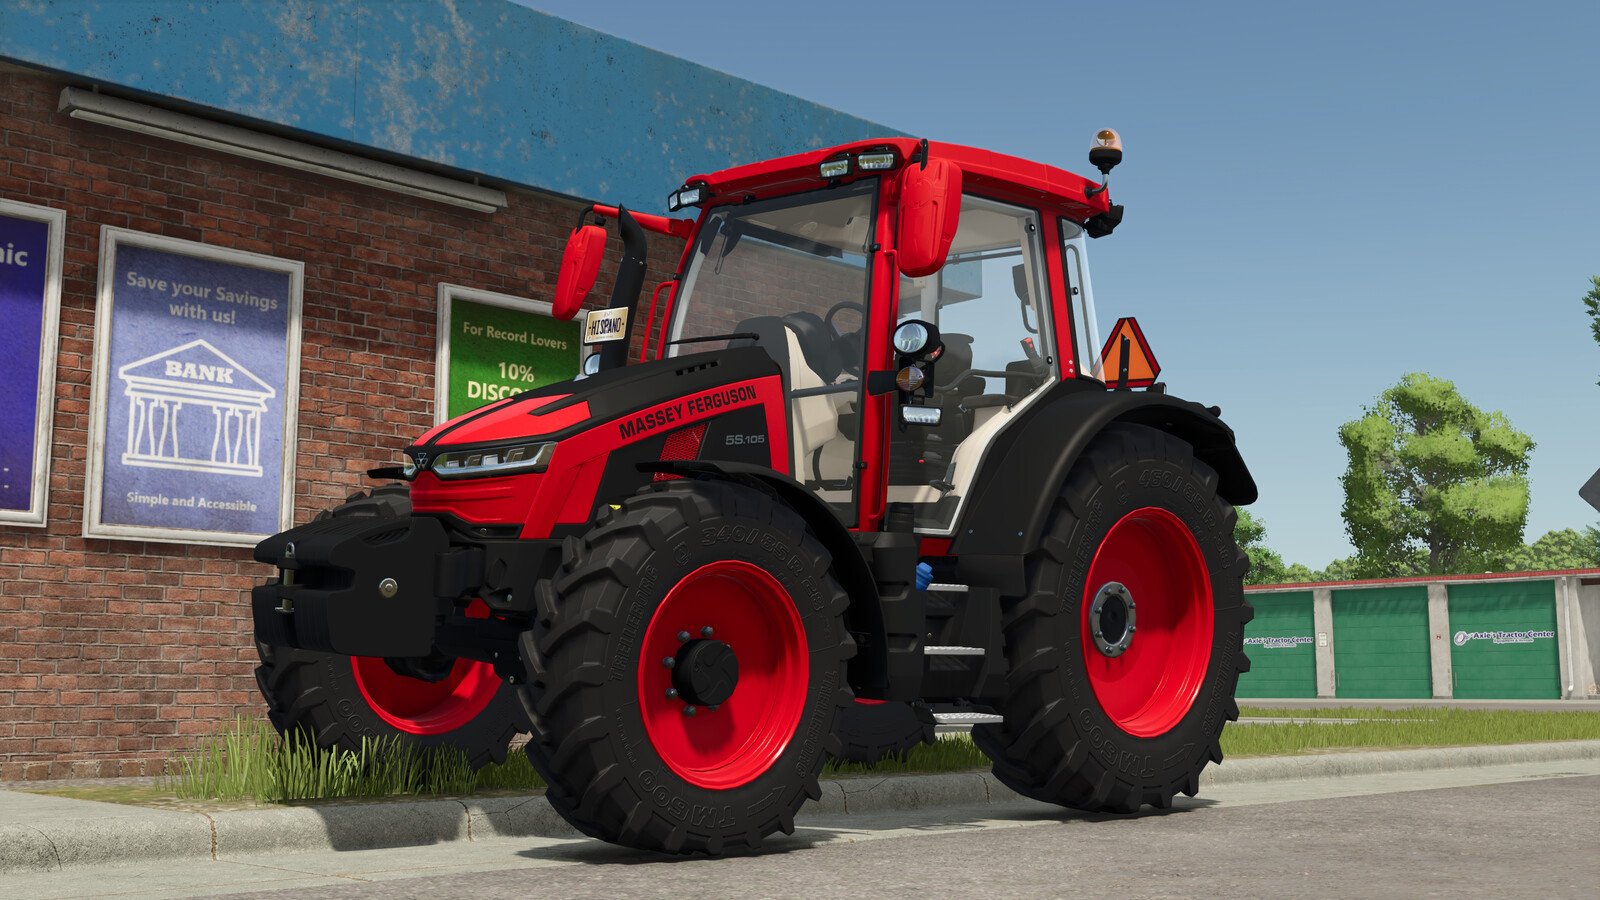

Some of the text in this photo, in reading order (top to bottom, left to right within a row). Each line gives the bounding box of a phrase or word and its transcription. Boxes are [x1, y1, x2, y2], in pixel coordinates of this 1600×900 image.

[126, 271, 278, 312] Save your Savings
[169, 301, 236, 325] with us!
[463, 321, 567, 351] For Record Lovers
[165, 360, 235, 385] BANK
[498, 361, 535, 383] 10%
[618, 384, 757, 440] MASSEY FERGUSON
[725, 434, 765, 446] 5S.105
[127, 491, 257, 513] Simple and Accessible
[1473, 631, 1496, 639] Axle's
[1527, 630, 1555, 638] Center
